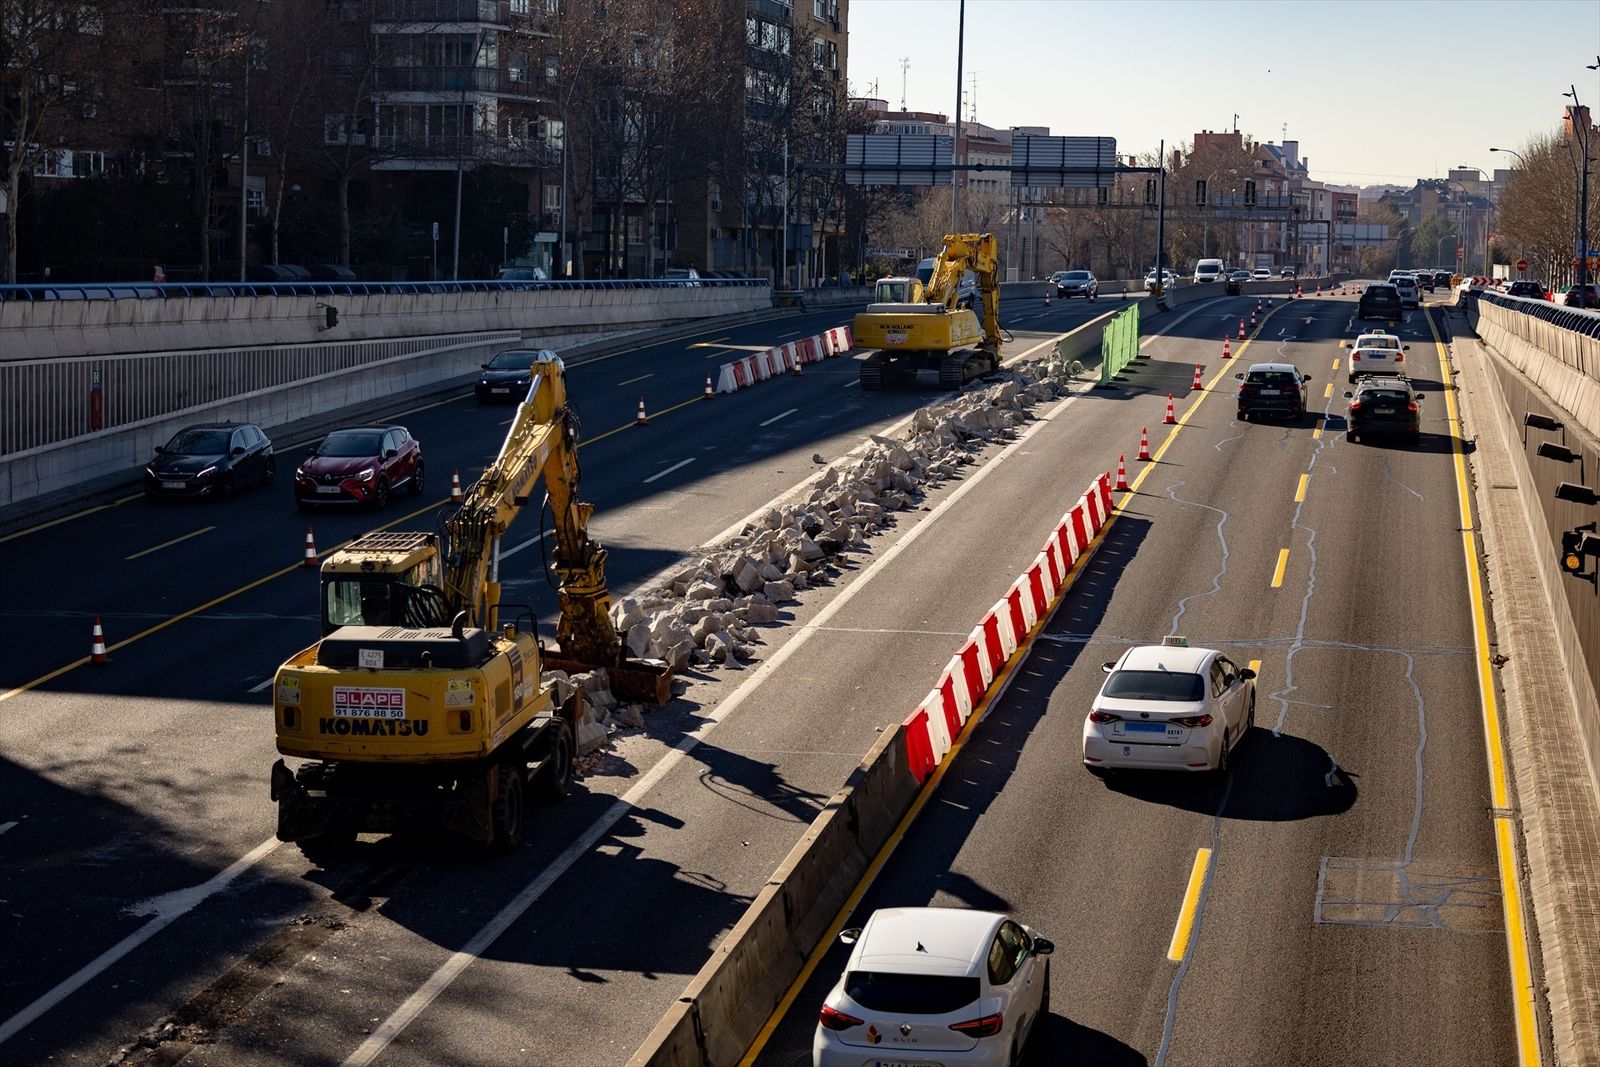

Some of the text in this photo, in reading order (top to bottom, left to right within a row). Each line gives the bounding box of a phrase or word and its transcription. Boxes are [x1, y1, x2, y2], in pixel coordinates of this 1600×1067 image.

[336, 692, 402, 705] BLAPE
[351, 709, 371, 717] 876
[390, 710, 403, 718] 50
[319, 718, 429, 737] KOMATSU
